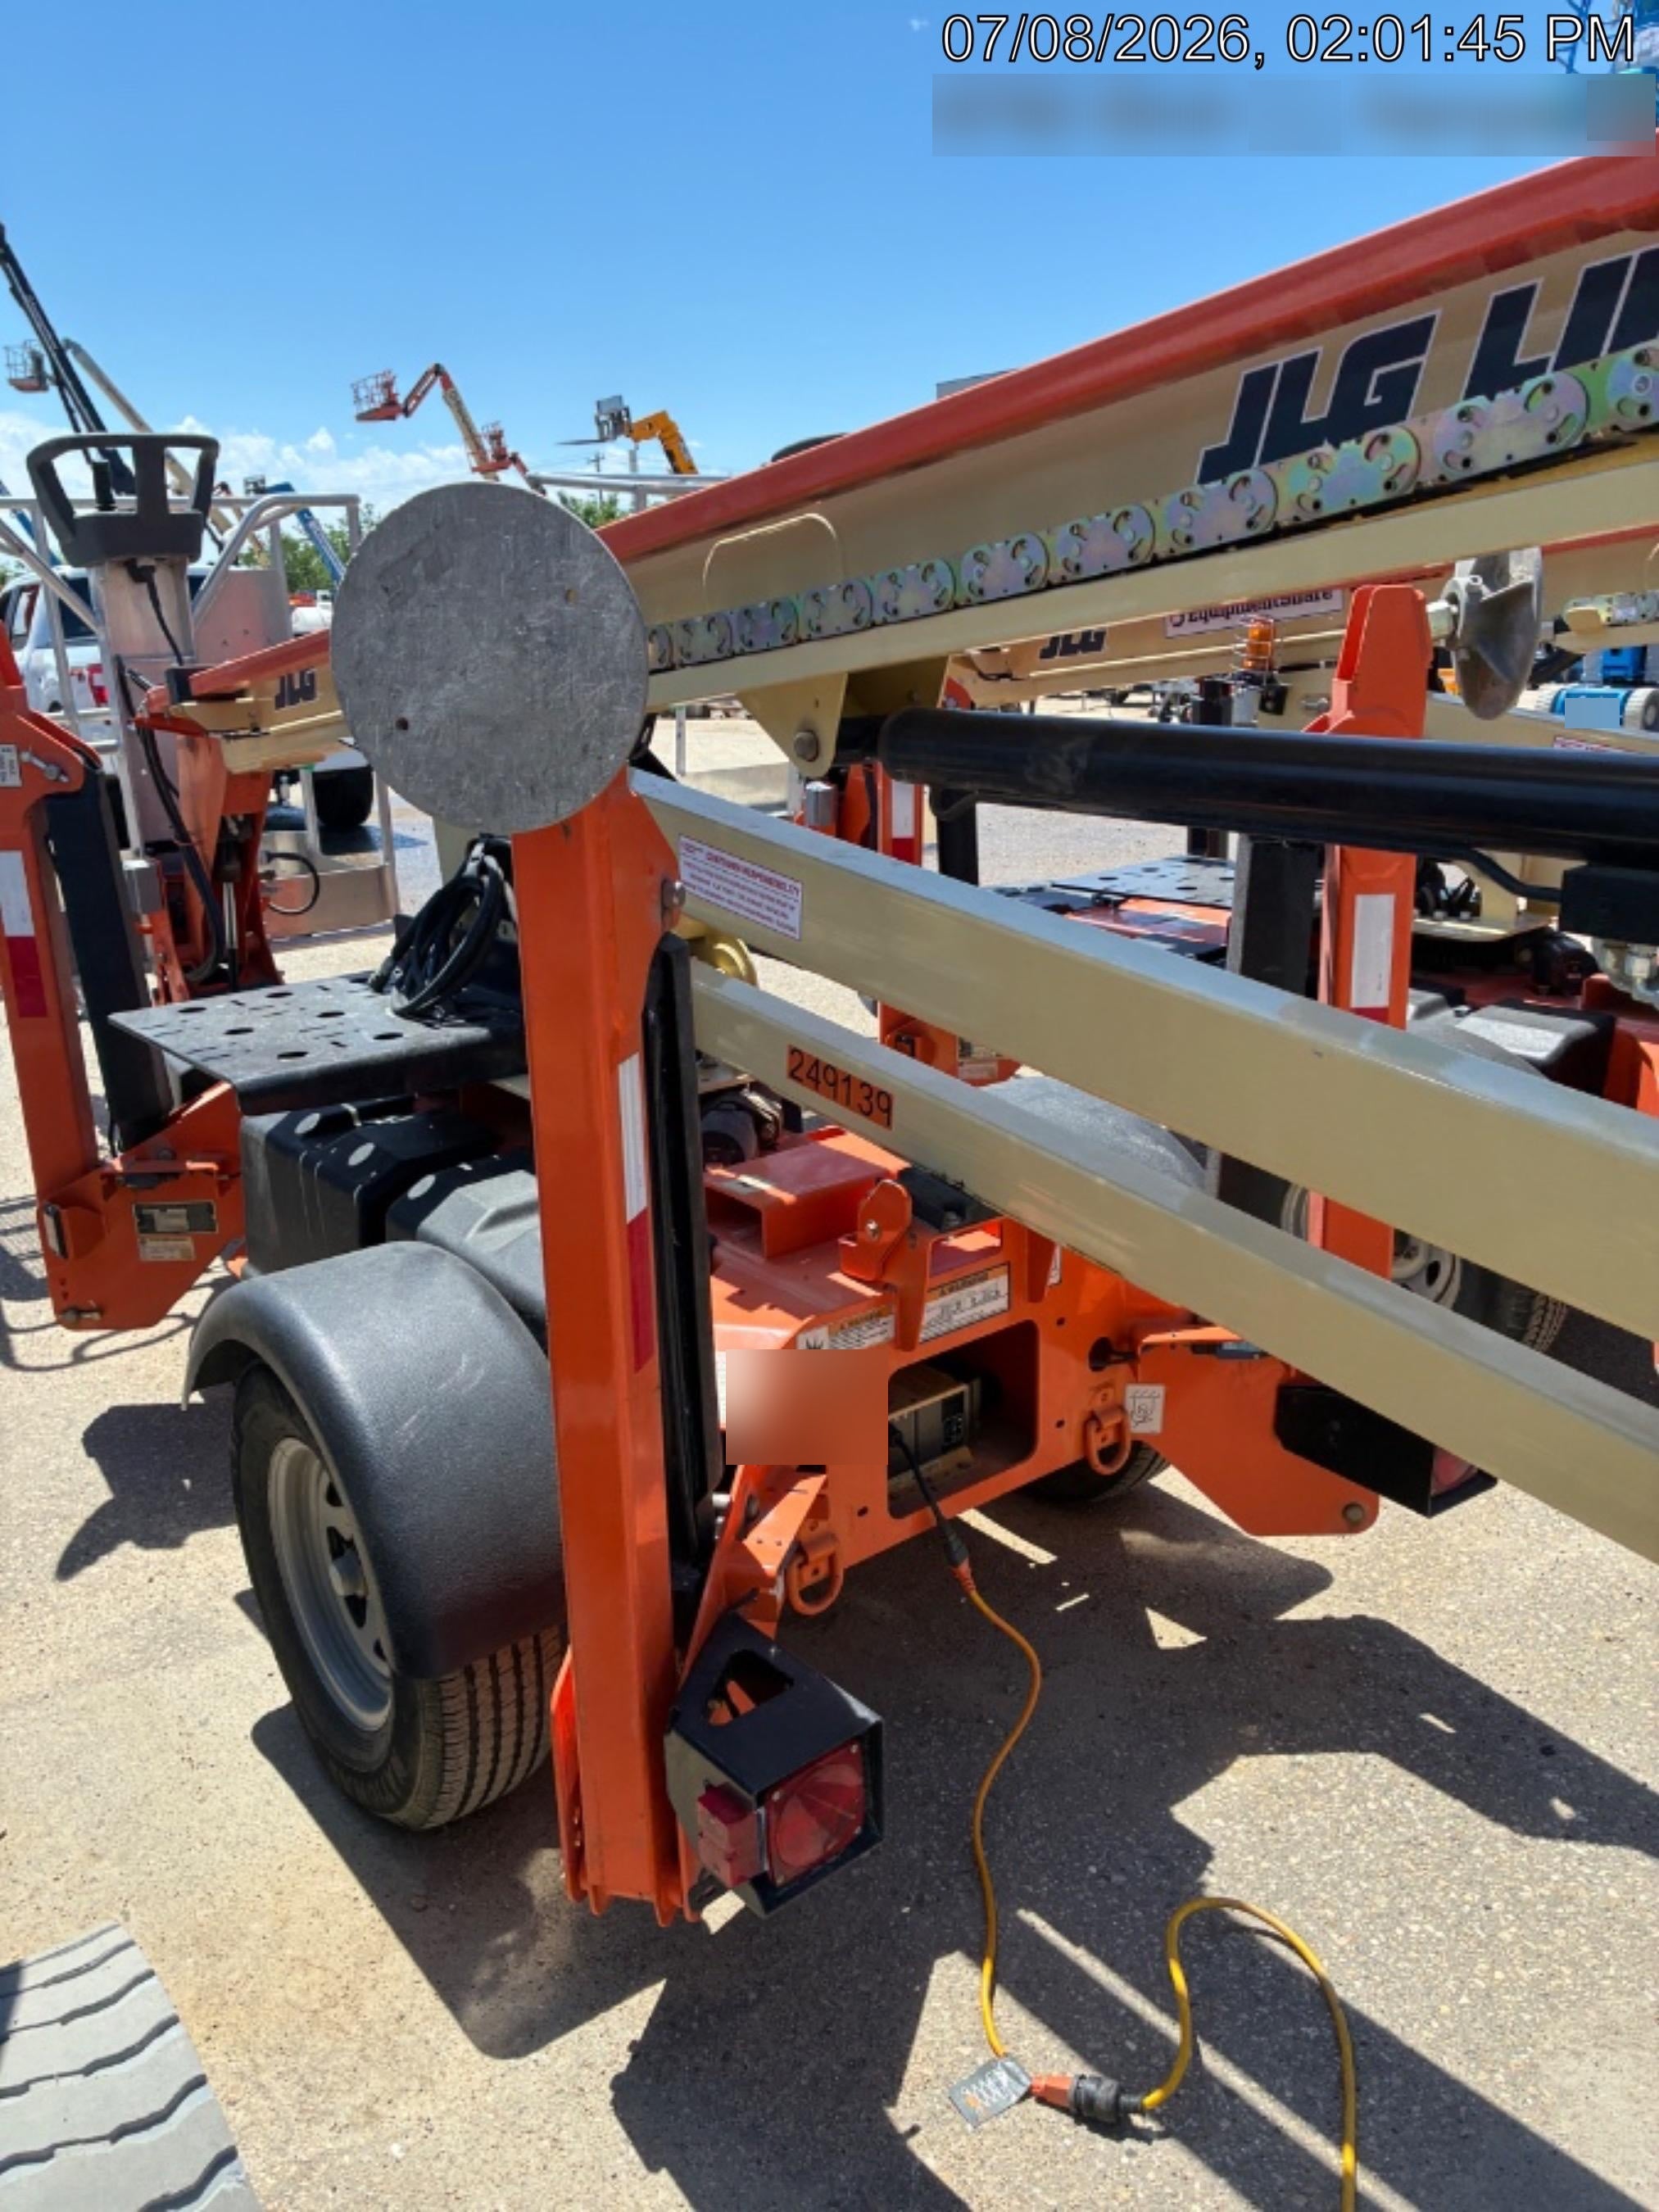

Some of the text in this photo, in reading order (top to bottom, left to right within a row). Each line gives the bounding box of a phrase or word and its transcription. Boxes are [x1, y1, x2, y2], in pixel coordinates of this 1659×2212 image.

[1197, 310, 1439, 485] JLG
[274, 668, 315, 710] JLG
[789, 1048, 891, 1128] 249139
